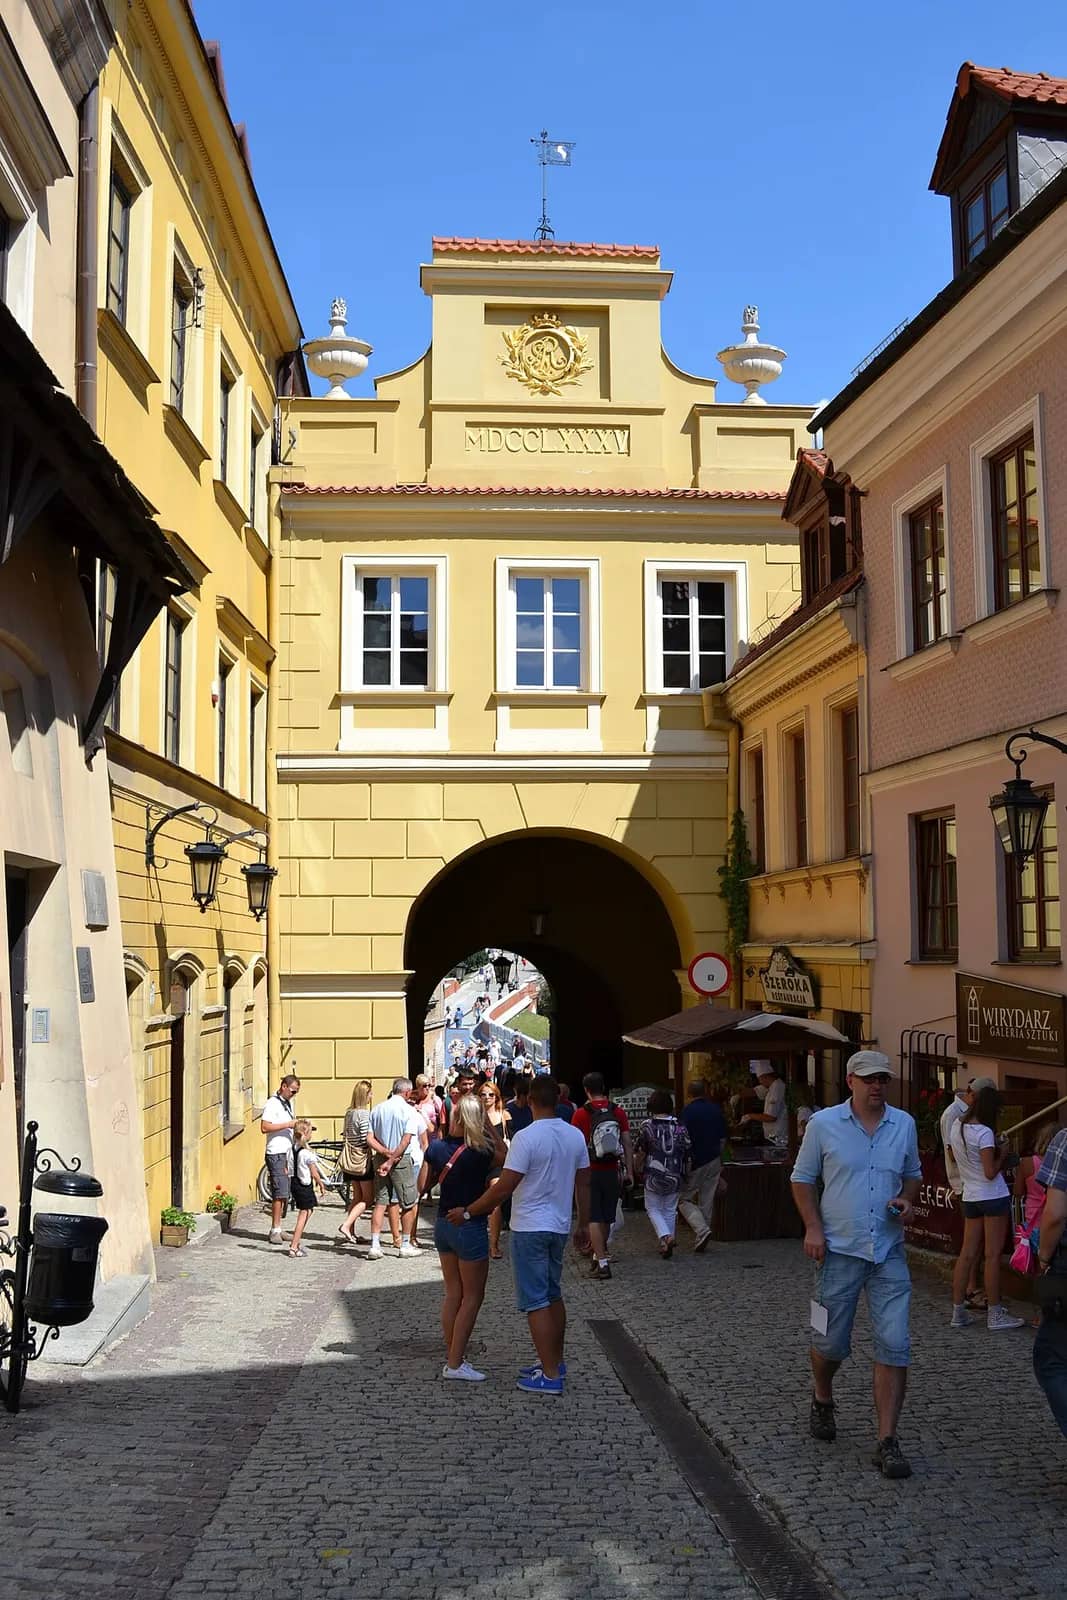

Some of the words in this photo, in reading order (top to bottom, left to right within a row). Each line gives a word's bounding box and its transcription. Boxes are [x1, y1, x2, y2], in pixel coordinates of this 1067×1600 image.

[465, 428, 630, 454] MDCCLXXXV
[765, 975, 810, 993] SZEROKA
[982, 1007, 1051, 1030] WIRYDARZ
[990, 1026, 1025, 1039] GALERIA
[1026, 1029, 1059, 1042] SZTUKI
